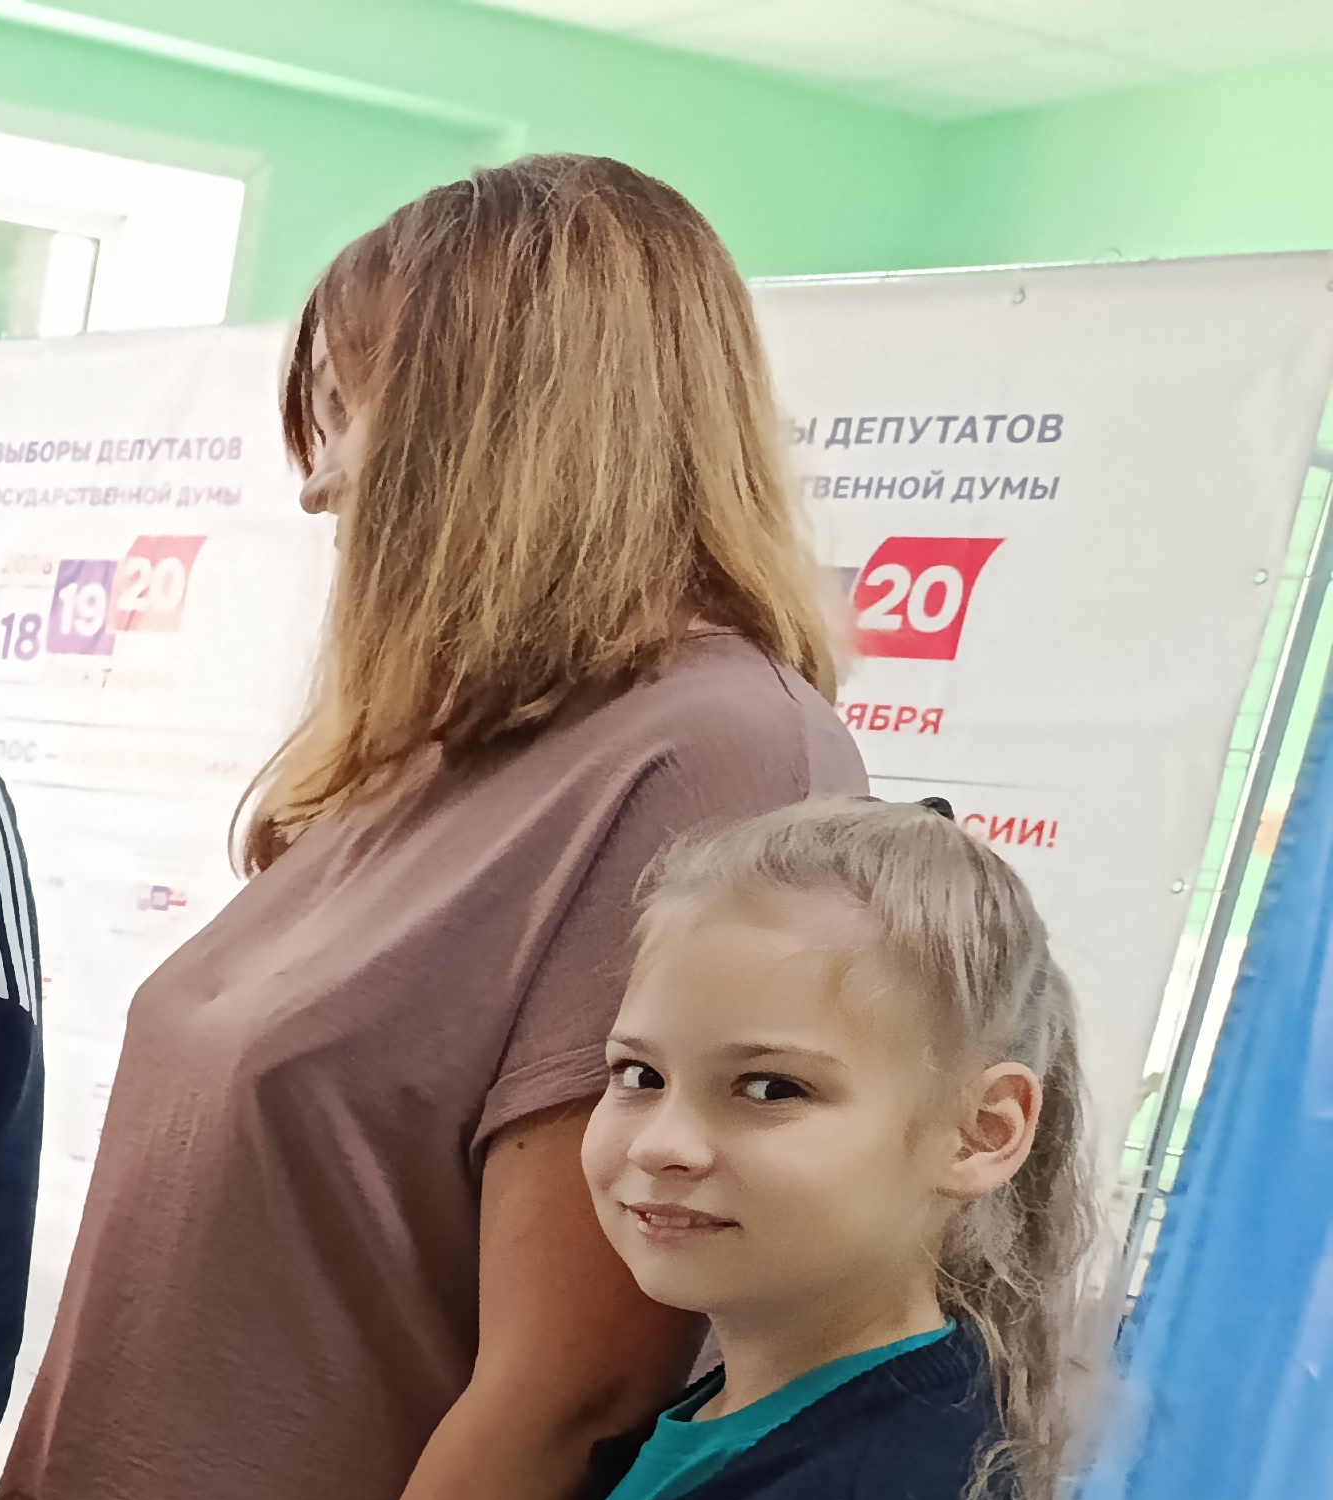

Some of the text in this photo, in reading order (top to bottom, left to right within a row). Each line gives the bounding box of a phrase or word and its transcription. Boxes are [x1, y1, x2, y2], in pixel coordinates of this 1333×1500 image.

[824, 413, 1064, 449] ДЕПУТАТОВ
[95, 436, 242, 465] ДЕПУТАТОВ
[176, 486, 242, 508] ДУМЫ
[799, 470, 1060, 503] ТВЕННОЙ ДУМЫ
[118, 556, 186, 613] 20
[856, 563, 964, 634] 20
[58, 582, 107, 637] 19
[1, 612, 42, 661] 18
[837, 703, 944, 734] ЯБРЯ
[962, 813, 1059, 848] СИИ!
